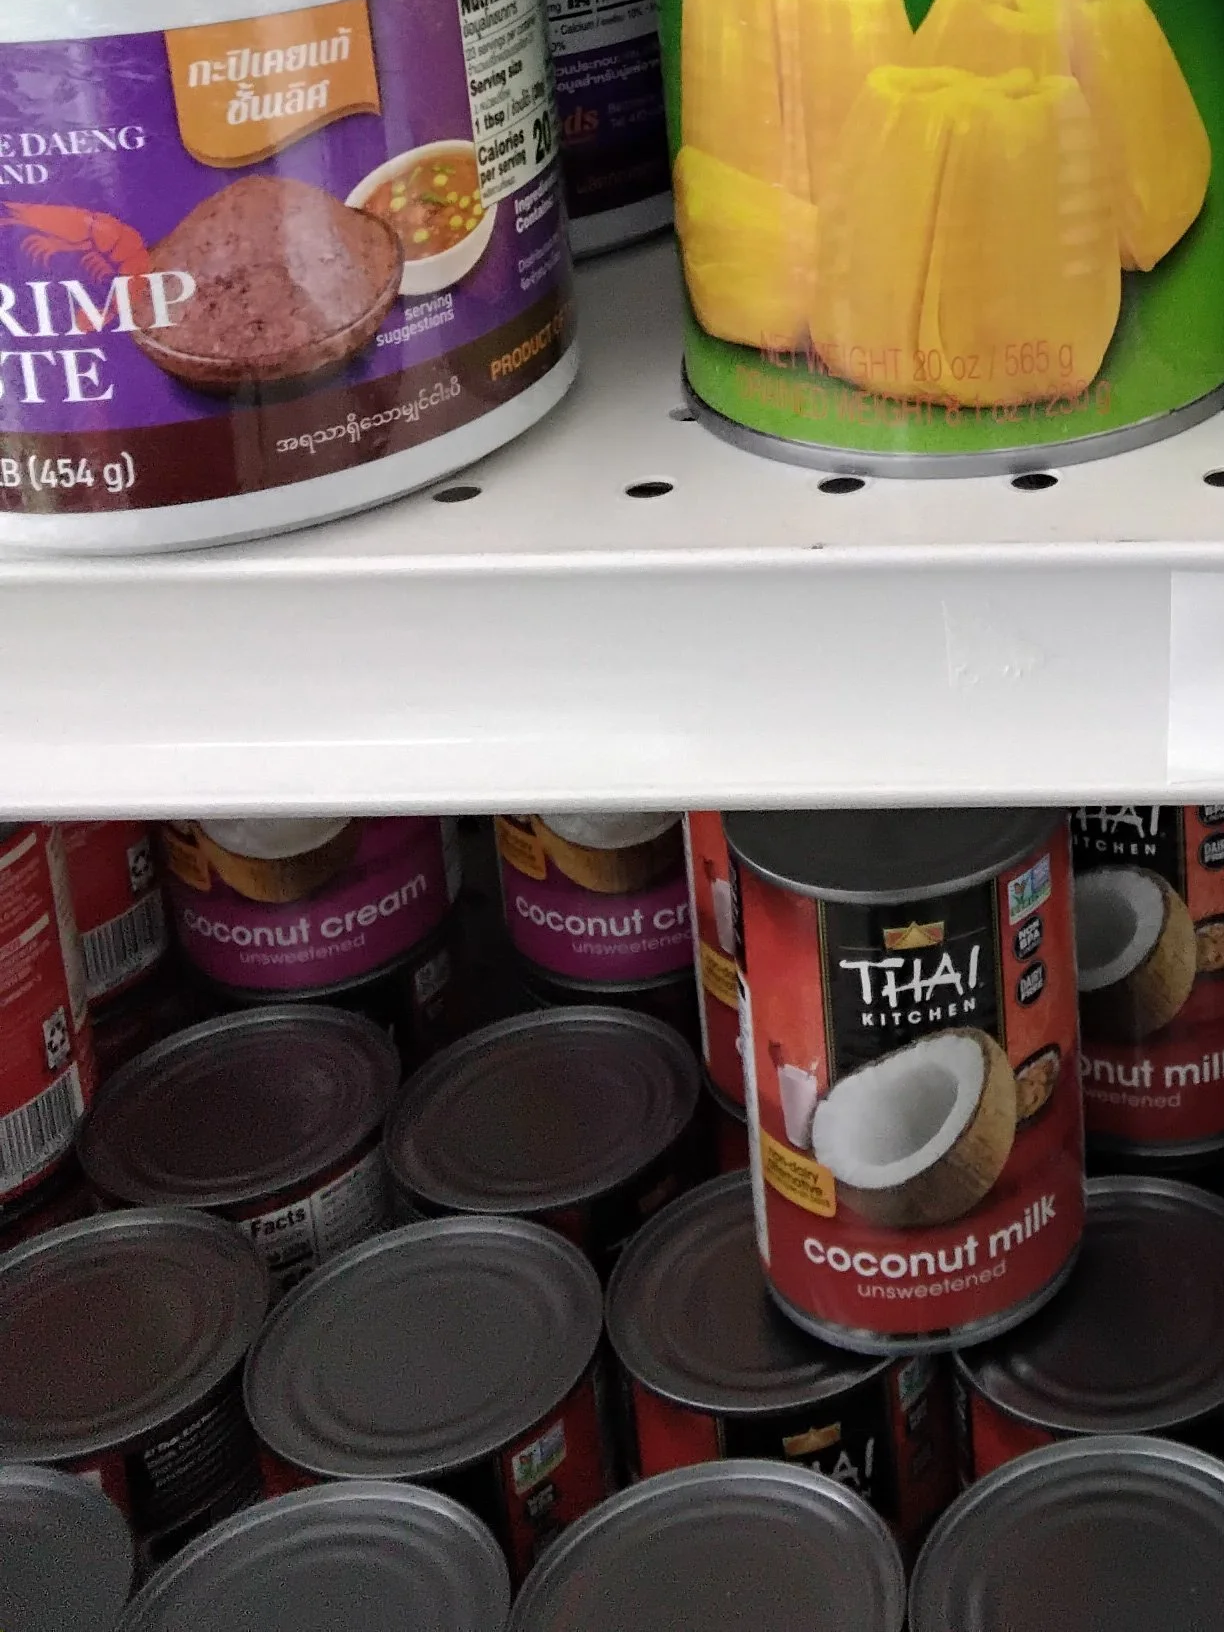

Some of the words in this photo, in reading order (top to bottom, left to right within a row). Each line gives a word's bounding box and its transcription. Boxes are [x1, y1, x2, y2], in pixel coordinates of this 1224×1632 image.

[20, 125, 146, 158] DAENG
[478, 127, 525, 166] Calories
[532, 110, 552, 165] 20
[404, 293, 453, 321] serving
[376, 308, 455, 348] suggestions
[0, 348, 115, 404] TE
[951, 355, 981, 380] oz
[1004, 340, 1051, 377] 565
[1058, 343, 1075, 378] g
[28, 456, 95, 492] (454
[103, 451, 136, 494] g)
[183, 908, 310, 947] coconut
[320, 873, 429, 939] cream
[515, 896, 644, 937] coconut
[653, 903, 691, 930] cr
[239, 934, 367, 967] unsweetened
[839, 945, 982, 1008] THAI
[862, 998, 977, 1027] KITCHEN
[250, 1207, 305, 1238] Facts
[803, 1236, 978, 1279] coconut
[988, 1193, 1058, 1256] milk
[857, 1261, 1008, 1299] unsweetened
